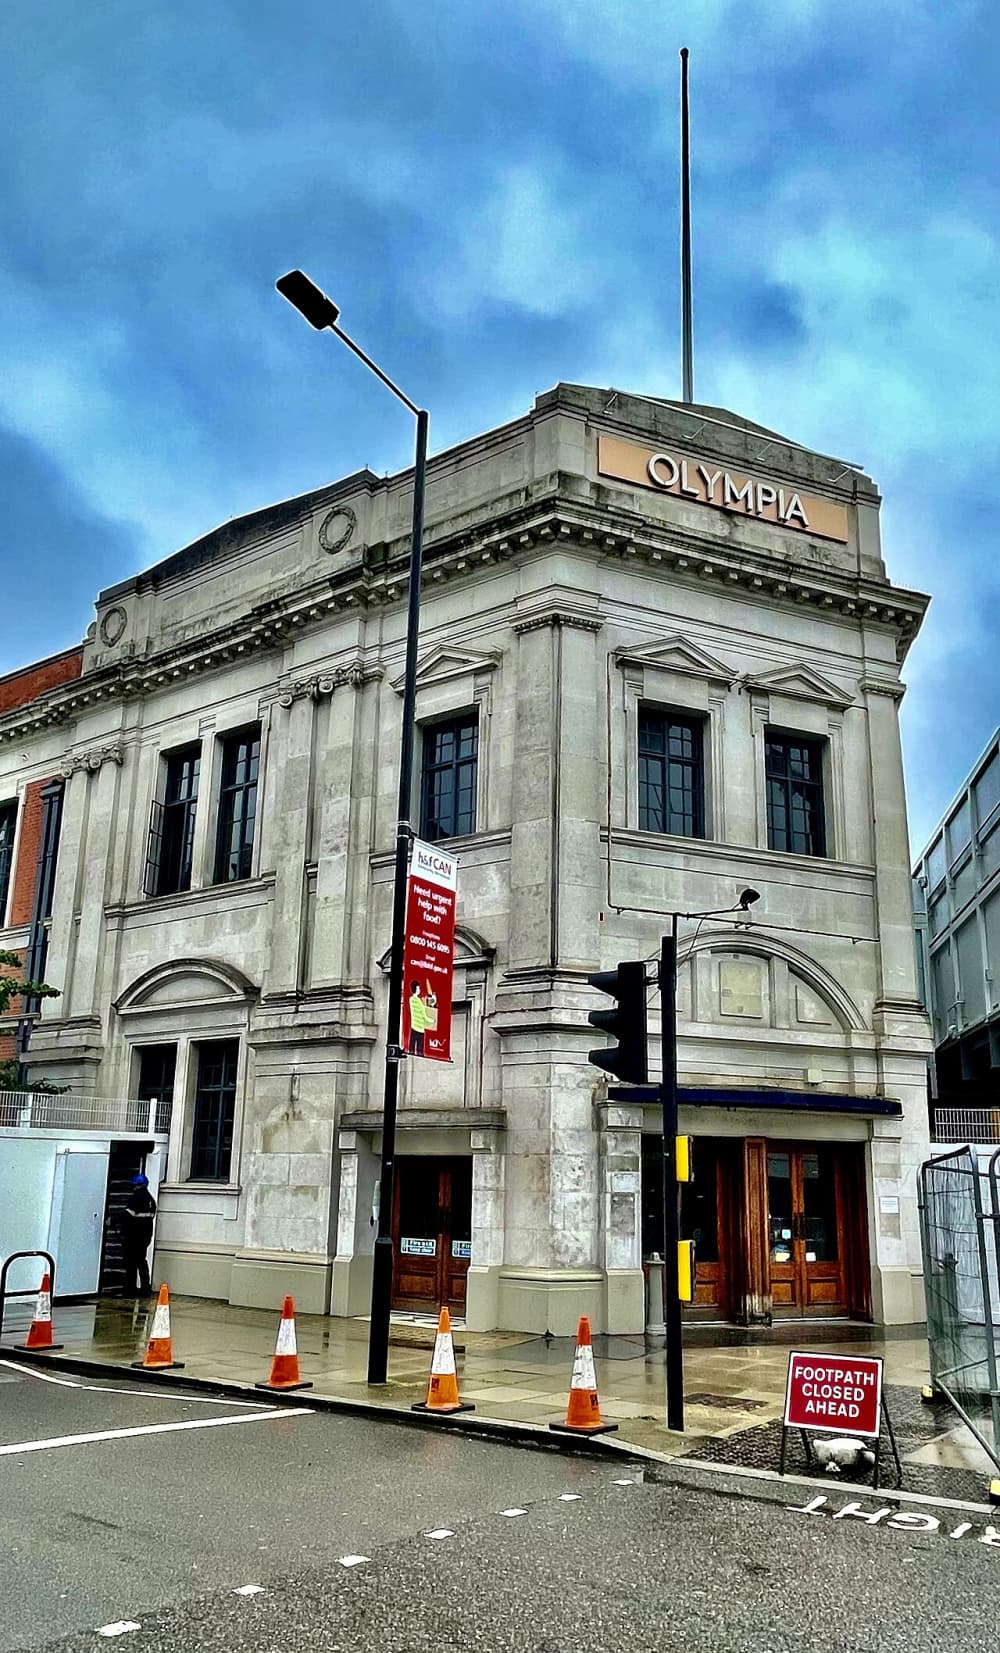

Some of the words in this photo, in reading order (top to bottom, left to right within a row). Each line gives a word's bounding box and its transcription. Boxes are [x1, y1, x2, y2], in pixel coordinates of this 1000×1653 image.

[648, 453, 809, 528] OLYMPIA
[413, 884, 431, 898] Need
[431, 892, 453, 907] urgent
[417, 897, 433, 911] help
[433, 905, 447, 916] with
[423, 910, 442, 925] food?
[409, 935, 426, 947] 0800
[794, 1366, 875, 1386] FOOTPATH
[801, 1383, 865, 1401] CLOSED
[804, 1399, 860, 1418] AHEAD
